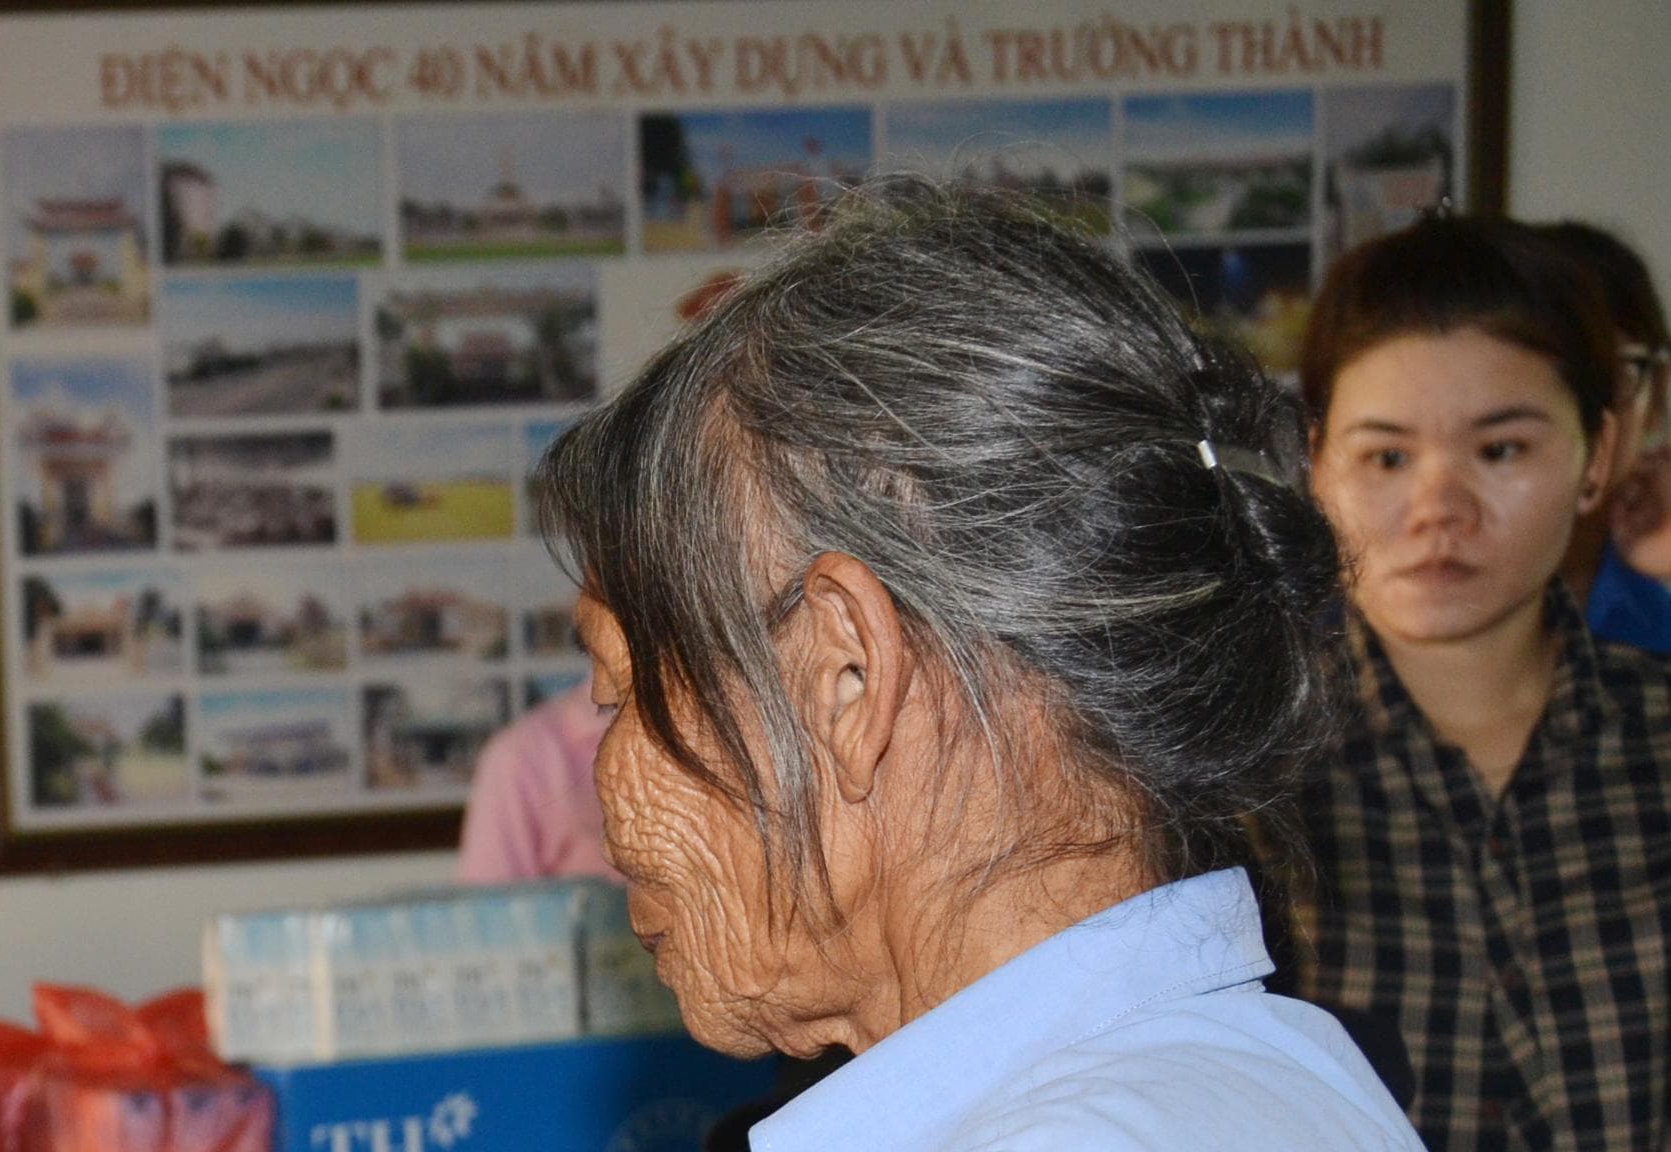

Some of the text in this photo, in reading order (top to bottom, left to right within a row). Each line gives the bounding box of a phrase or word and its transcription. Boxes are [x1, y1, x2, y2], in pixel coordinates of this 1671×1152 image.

[100, 44, 226, 114] ĐIỆN
[243, 47, 395, 112] NGỌC
[475, 32, 597, 95] NĂM
[610, 25, 722, 95] XÂY
[734, 32, 887, 97] DỰNG
[899, 16, 972, 85] VÀ
[986, 14, 1198, 83] TRƯỜNG
[1213, 6, 1384, 74] THÀNH
